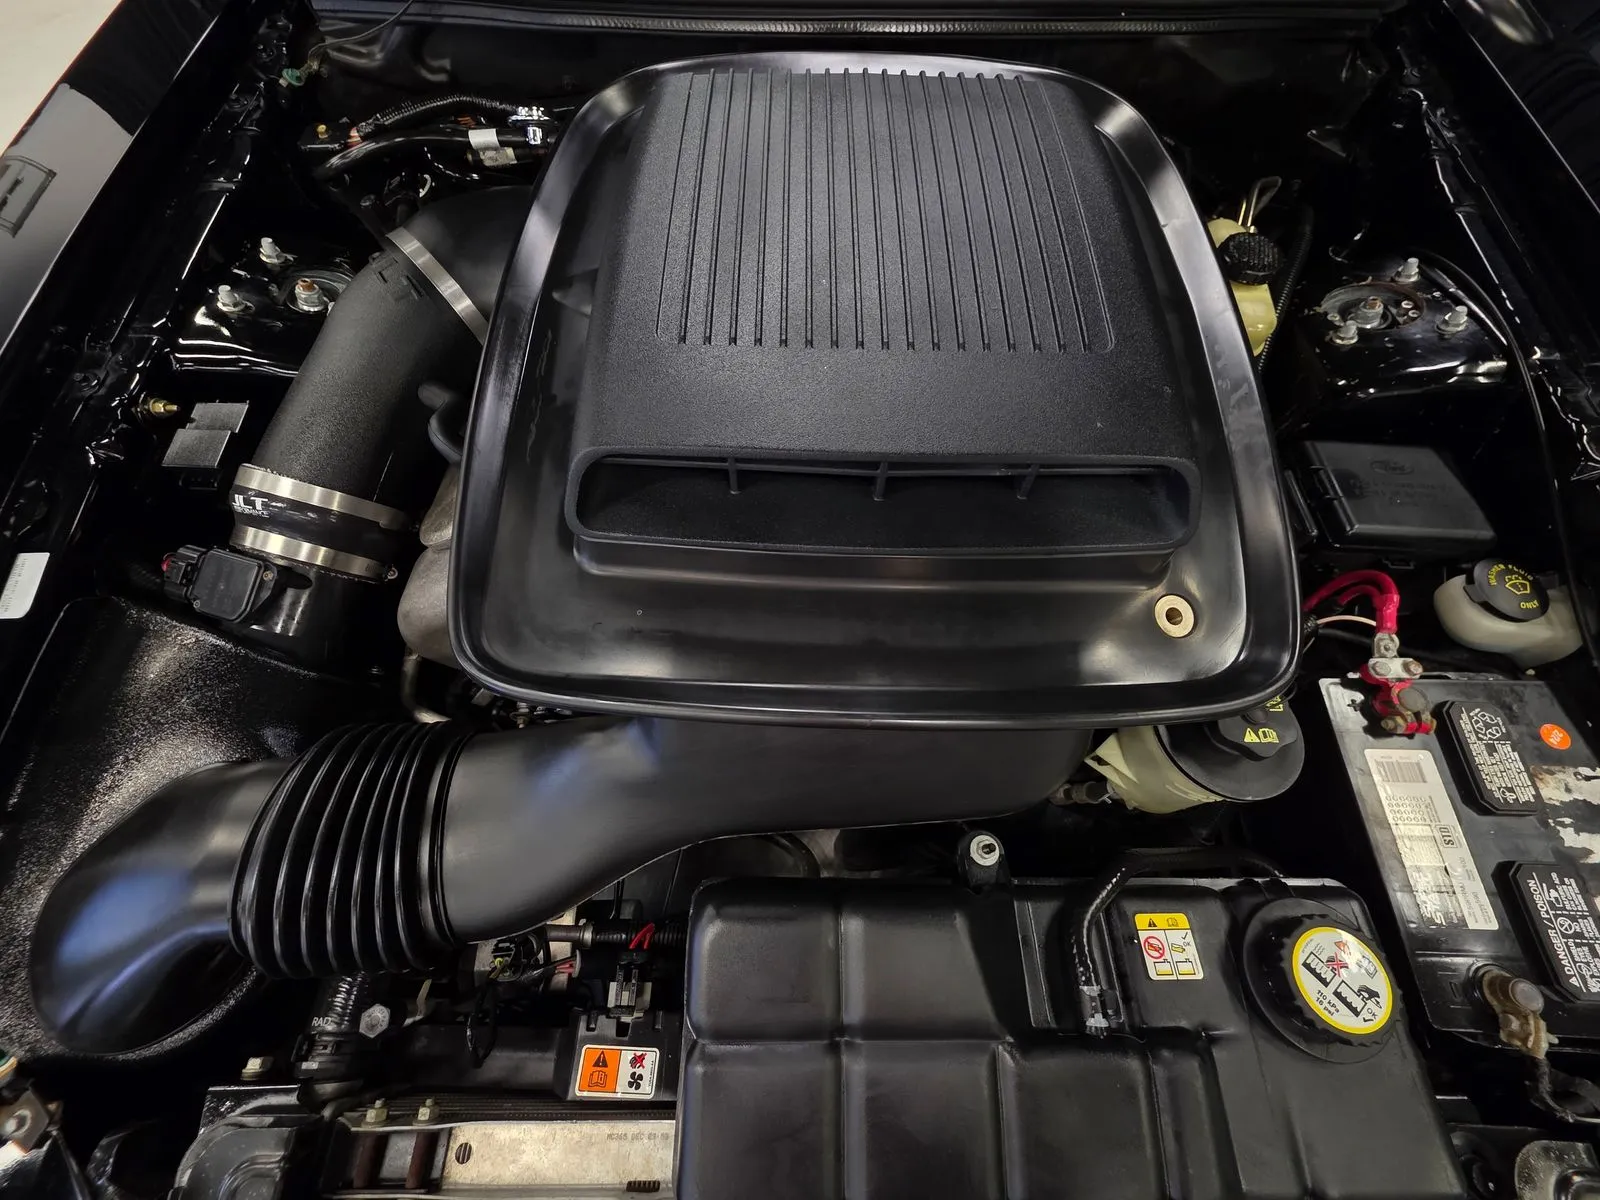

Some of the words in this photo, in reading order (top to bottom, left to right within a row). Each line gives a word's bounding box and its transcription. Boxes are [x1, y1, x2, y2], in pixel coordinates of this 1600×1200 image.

[232, 494, 269, 511] JLT
[1520, 599, 1540, 609] ONLY
[1440, 827, 1454, 846] STD
[1527, 880, 1550, 918] POISON
[1573, 922, 1582, 932] NO
[1547, 929, 1574, 975] DANGER
[1316, 989, 1328, 1000] 110
[1327, 1000, 1340, 1013] kPa
[1324, 1006, 1335, 1017] psi
[1366, 1007, 1379, 1020] OK
